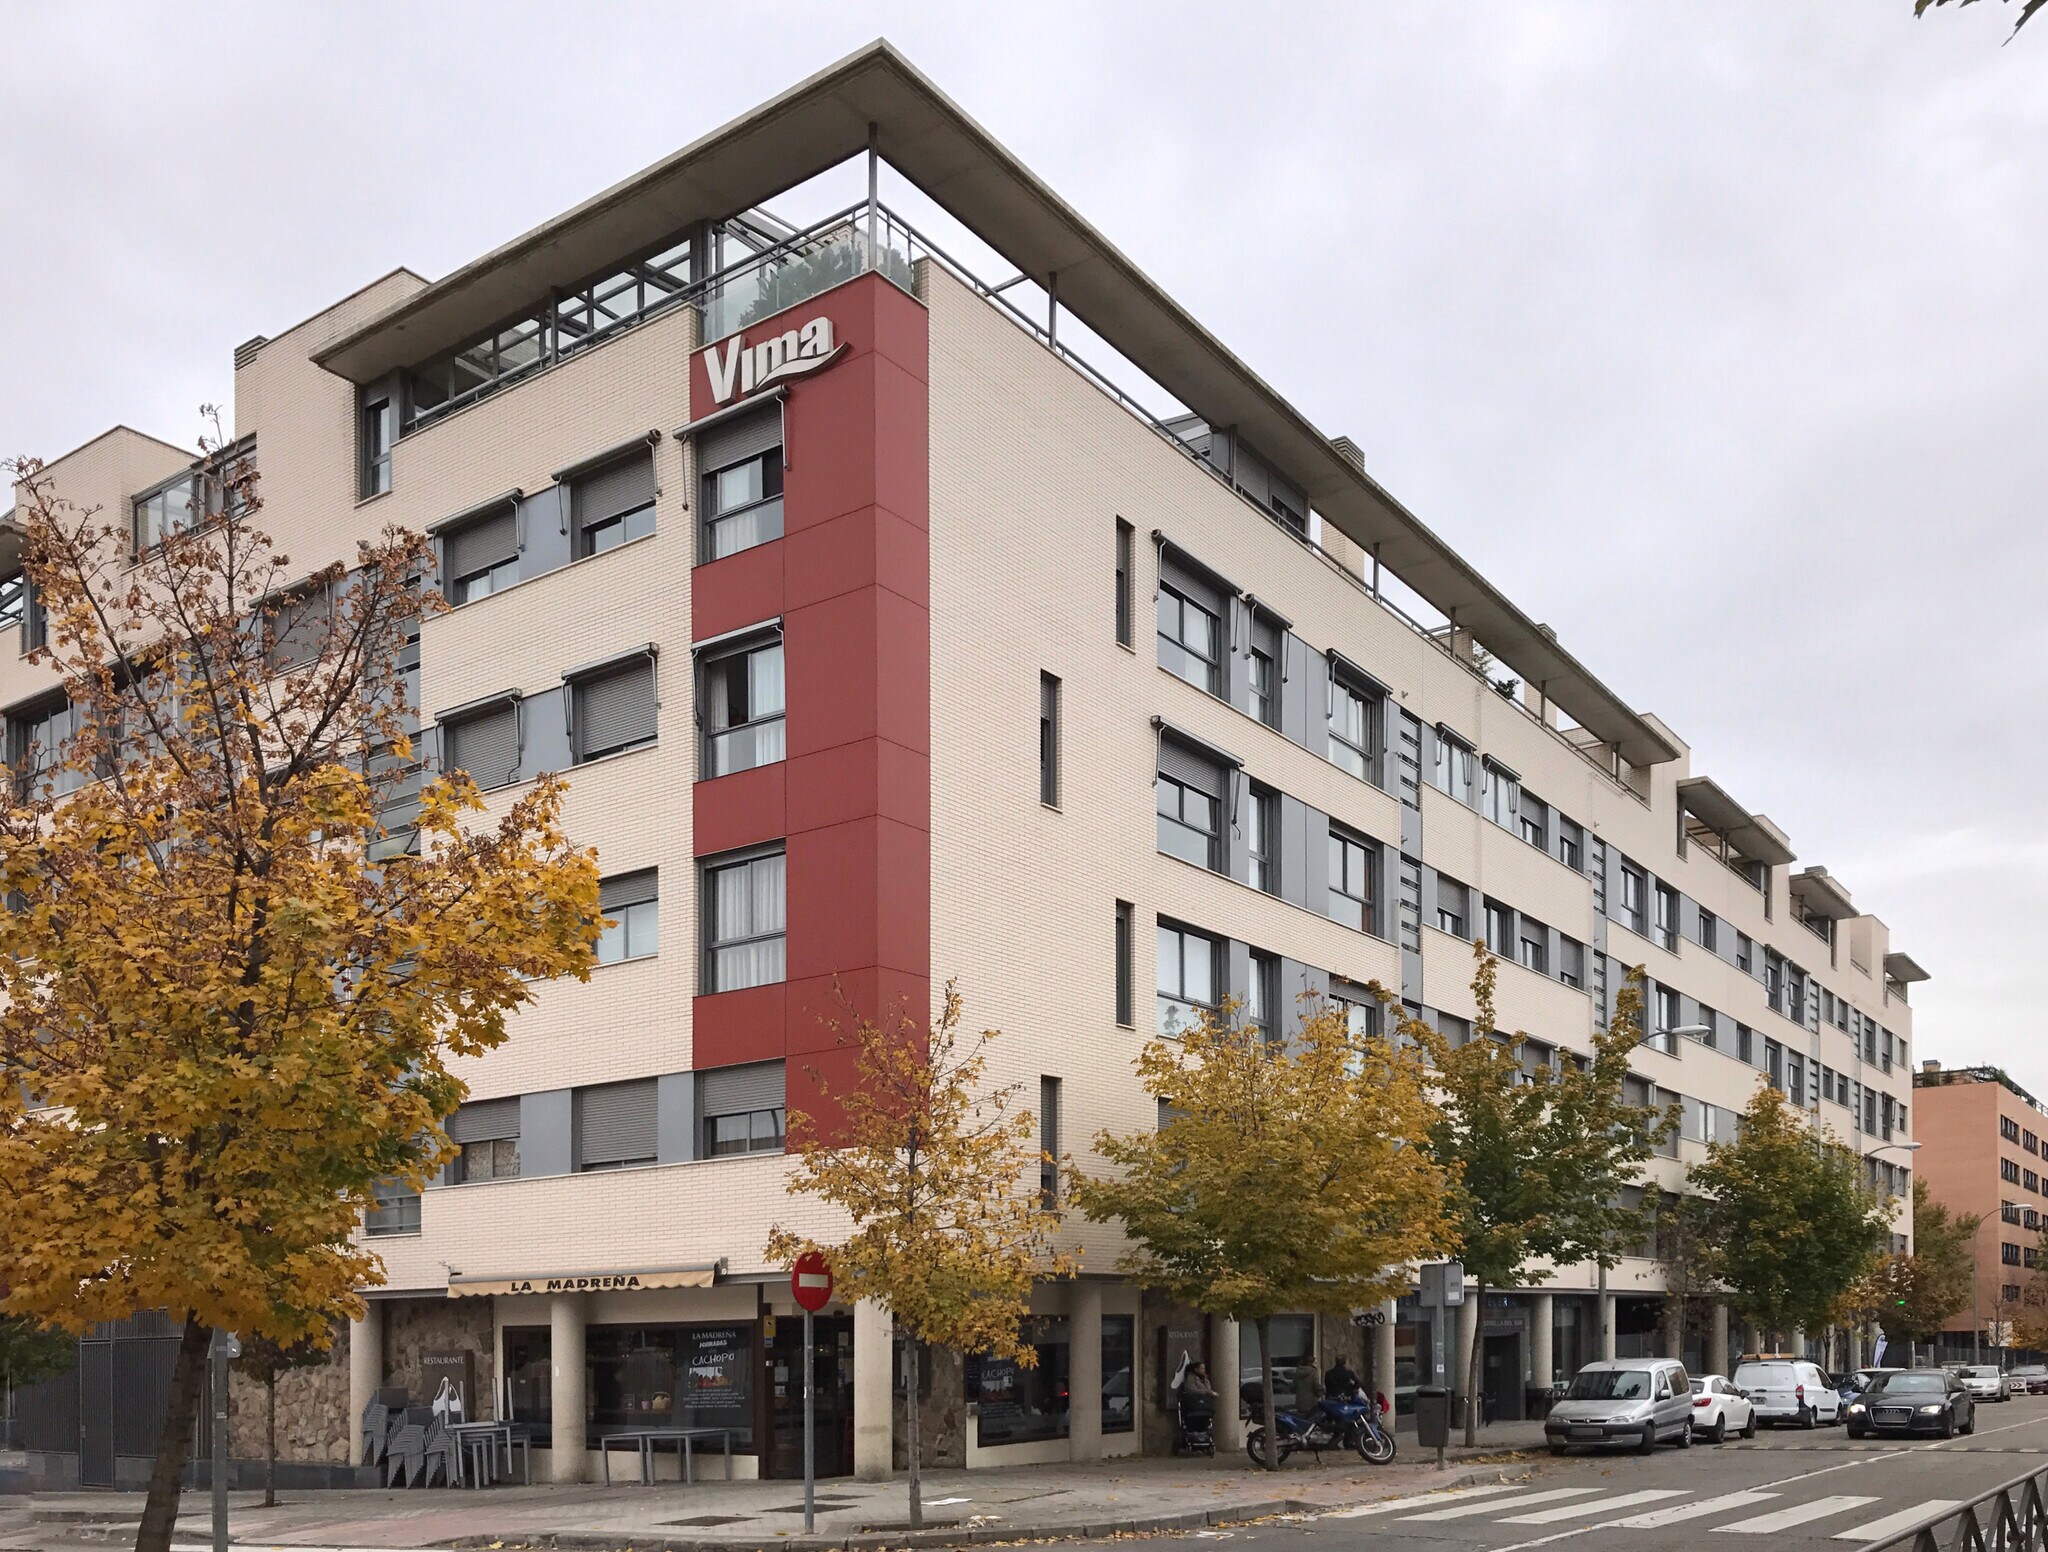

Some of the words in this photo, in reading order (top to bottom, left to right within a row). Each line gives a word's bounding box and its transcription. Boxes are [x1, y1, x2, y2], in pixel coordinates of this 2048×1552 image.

[703, 316, 834, 404] Vima
[511, 1282, 532, 1292] LA
[546, 1275, 640, 1290] MADREÑA
[423, 1356, 464, 1365] RESTAURANTE
[692, 1353, 735, 1366] CACHOPO
